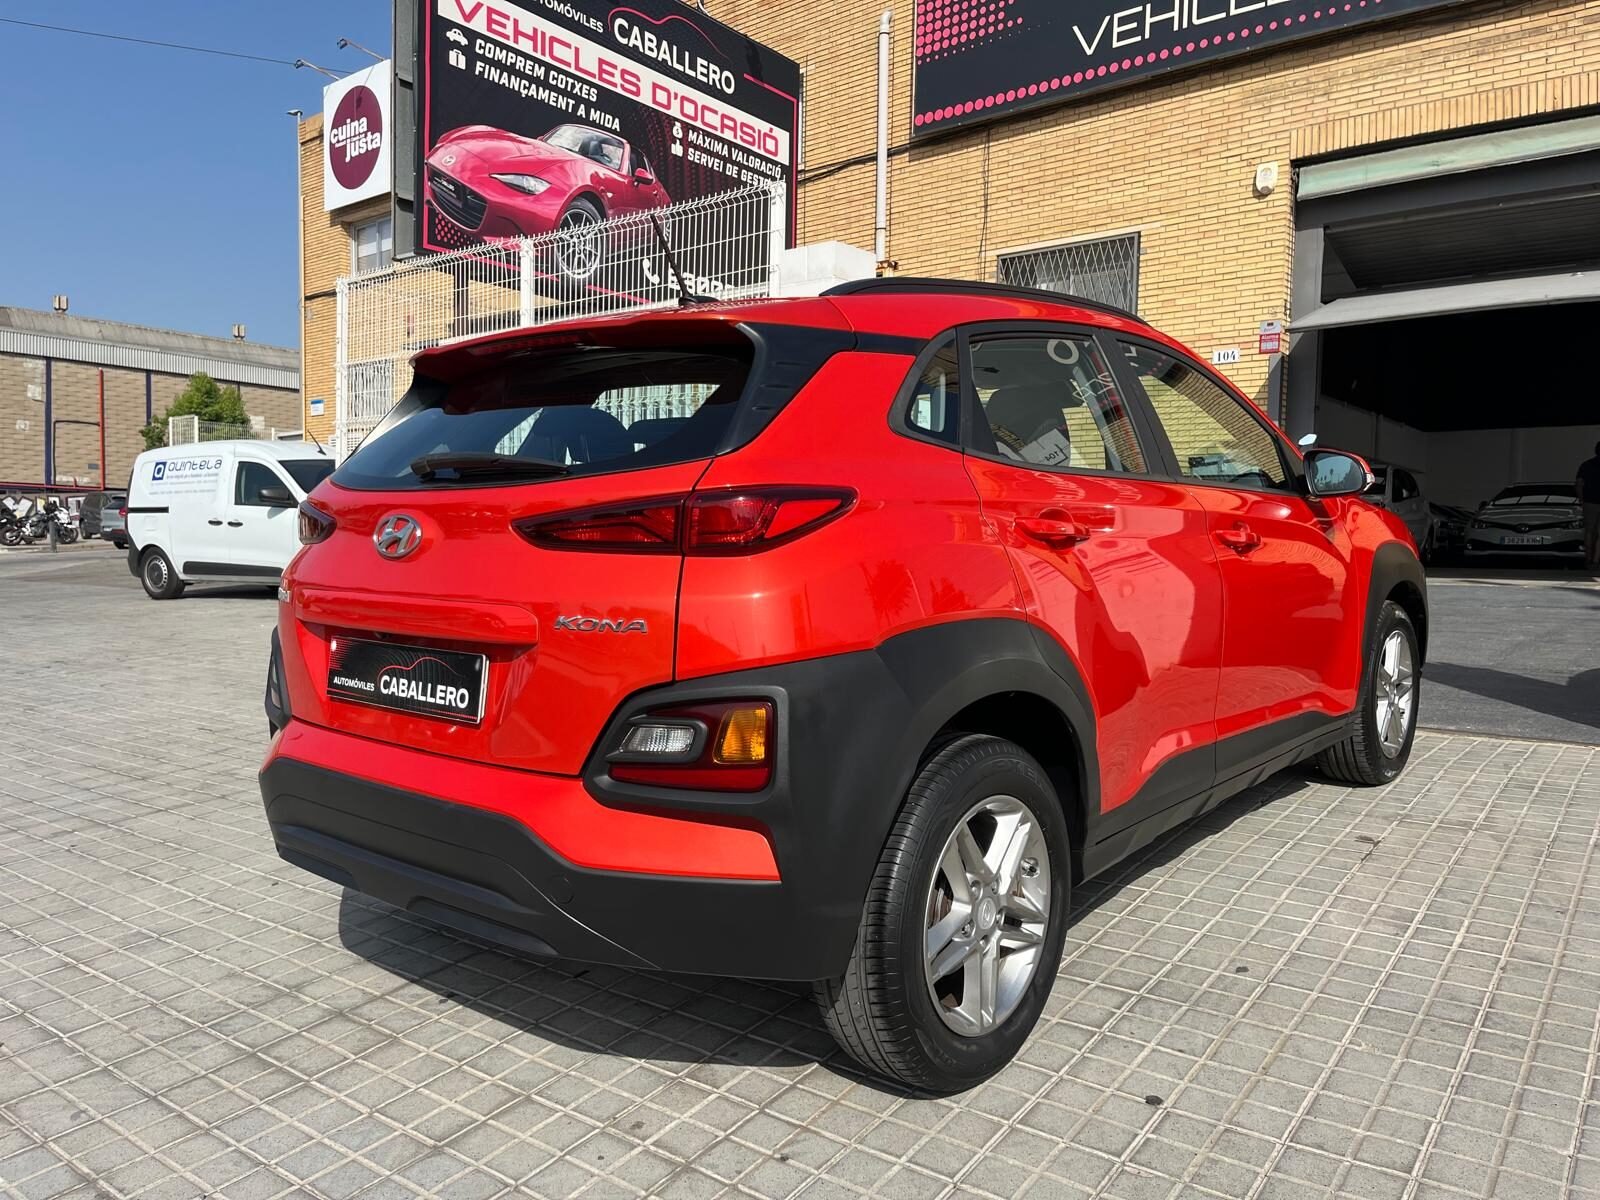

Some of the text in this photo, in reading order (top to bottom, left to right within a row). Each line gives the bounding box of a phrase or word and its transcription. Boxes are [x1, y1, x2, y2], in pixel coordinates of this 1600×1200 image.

[1072, 0, 1291, 56] VEHIC
[475, 38, 599, 102] COMPREM COTXES
[613, 17, 735, 95] CABALLERO
[455, 0, 779, 158] VEHICLES D'OCASIÓ
[475, 60, 621, 132] FINANÇAMENT A MIDA
[331, 116, 367, 144] cuina
[345, 131, 380, 162] justa
[687, 147, 723, 173] SERVEI
[725, 162, 738, 178] DE
[688, 129, 782, 179] MÀXIMA VALORACIÓ
[1217, 350, 1236, 362] 104
[554, 615, 648, 634] KONA
[333, 675, 470, 709] AUTOMÓVILES CABALLERO
